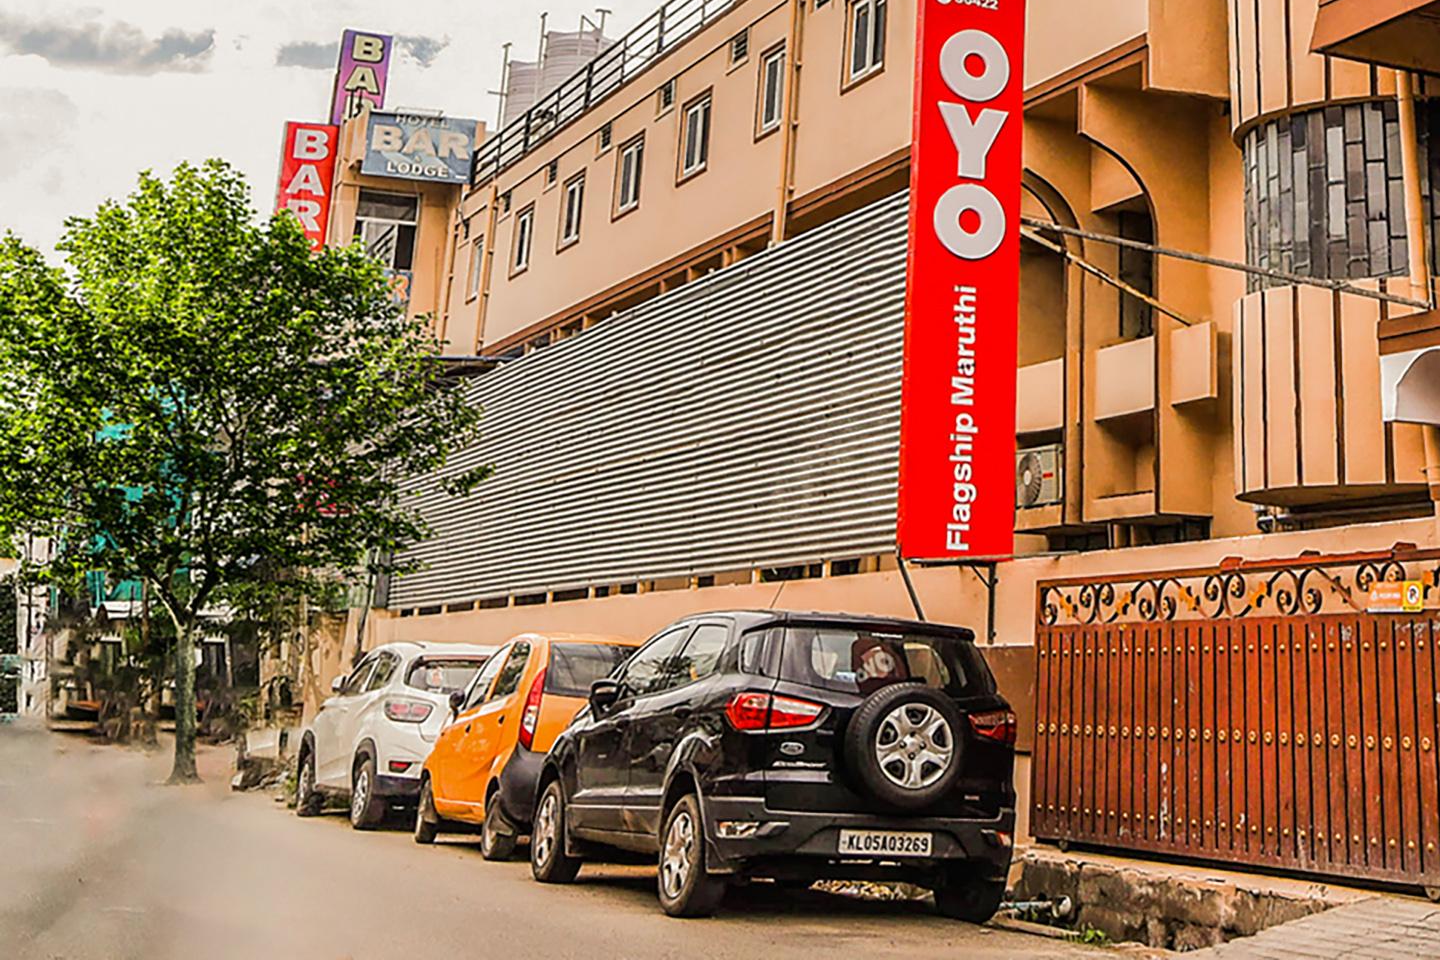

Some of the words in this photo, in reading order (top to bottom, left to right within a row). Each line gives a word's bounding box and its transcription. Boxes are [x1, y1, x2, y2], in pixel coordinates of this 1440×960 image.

[285, 128, 329, 232] BAR
[371, 124, 470, 160] BAR
[386, 161, 449, 178] LODGE
[933, 29, 1010, 259] OYO
[950, 285, 977, 406] Maruthi
[946, 413, 979, 551] Flagship
